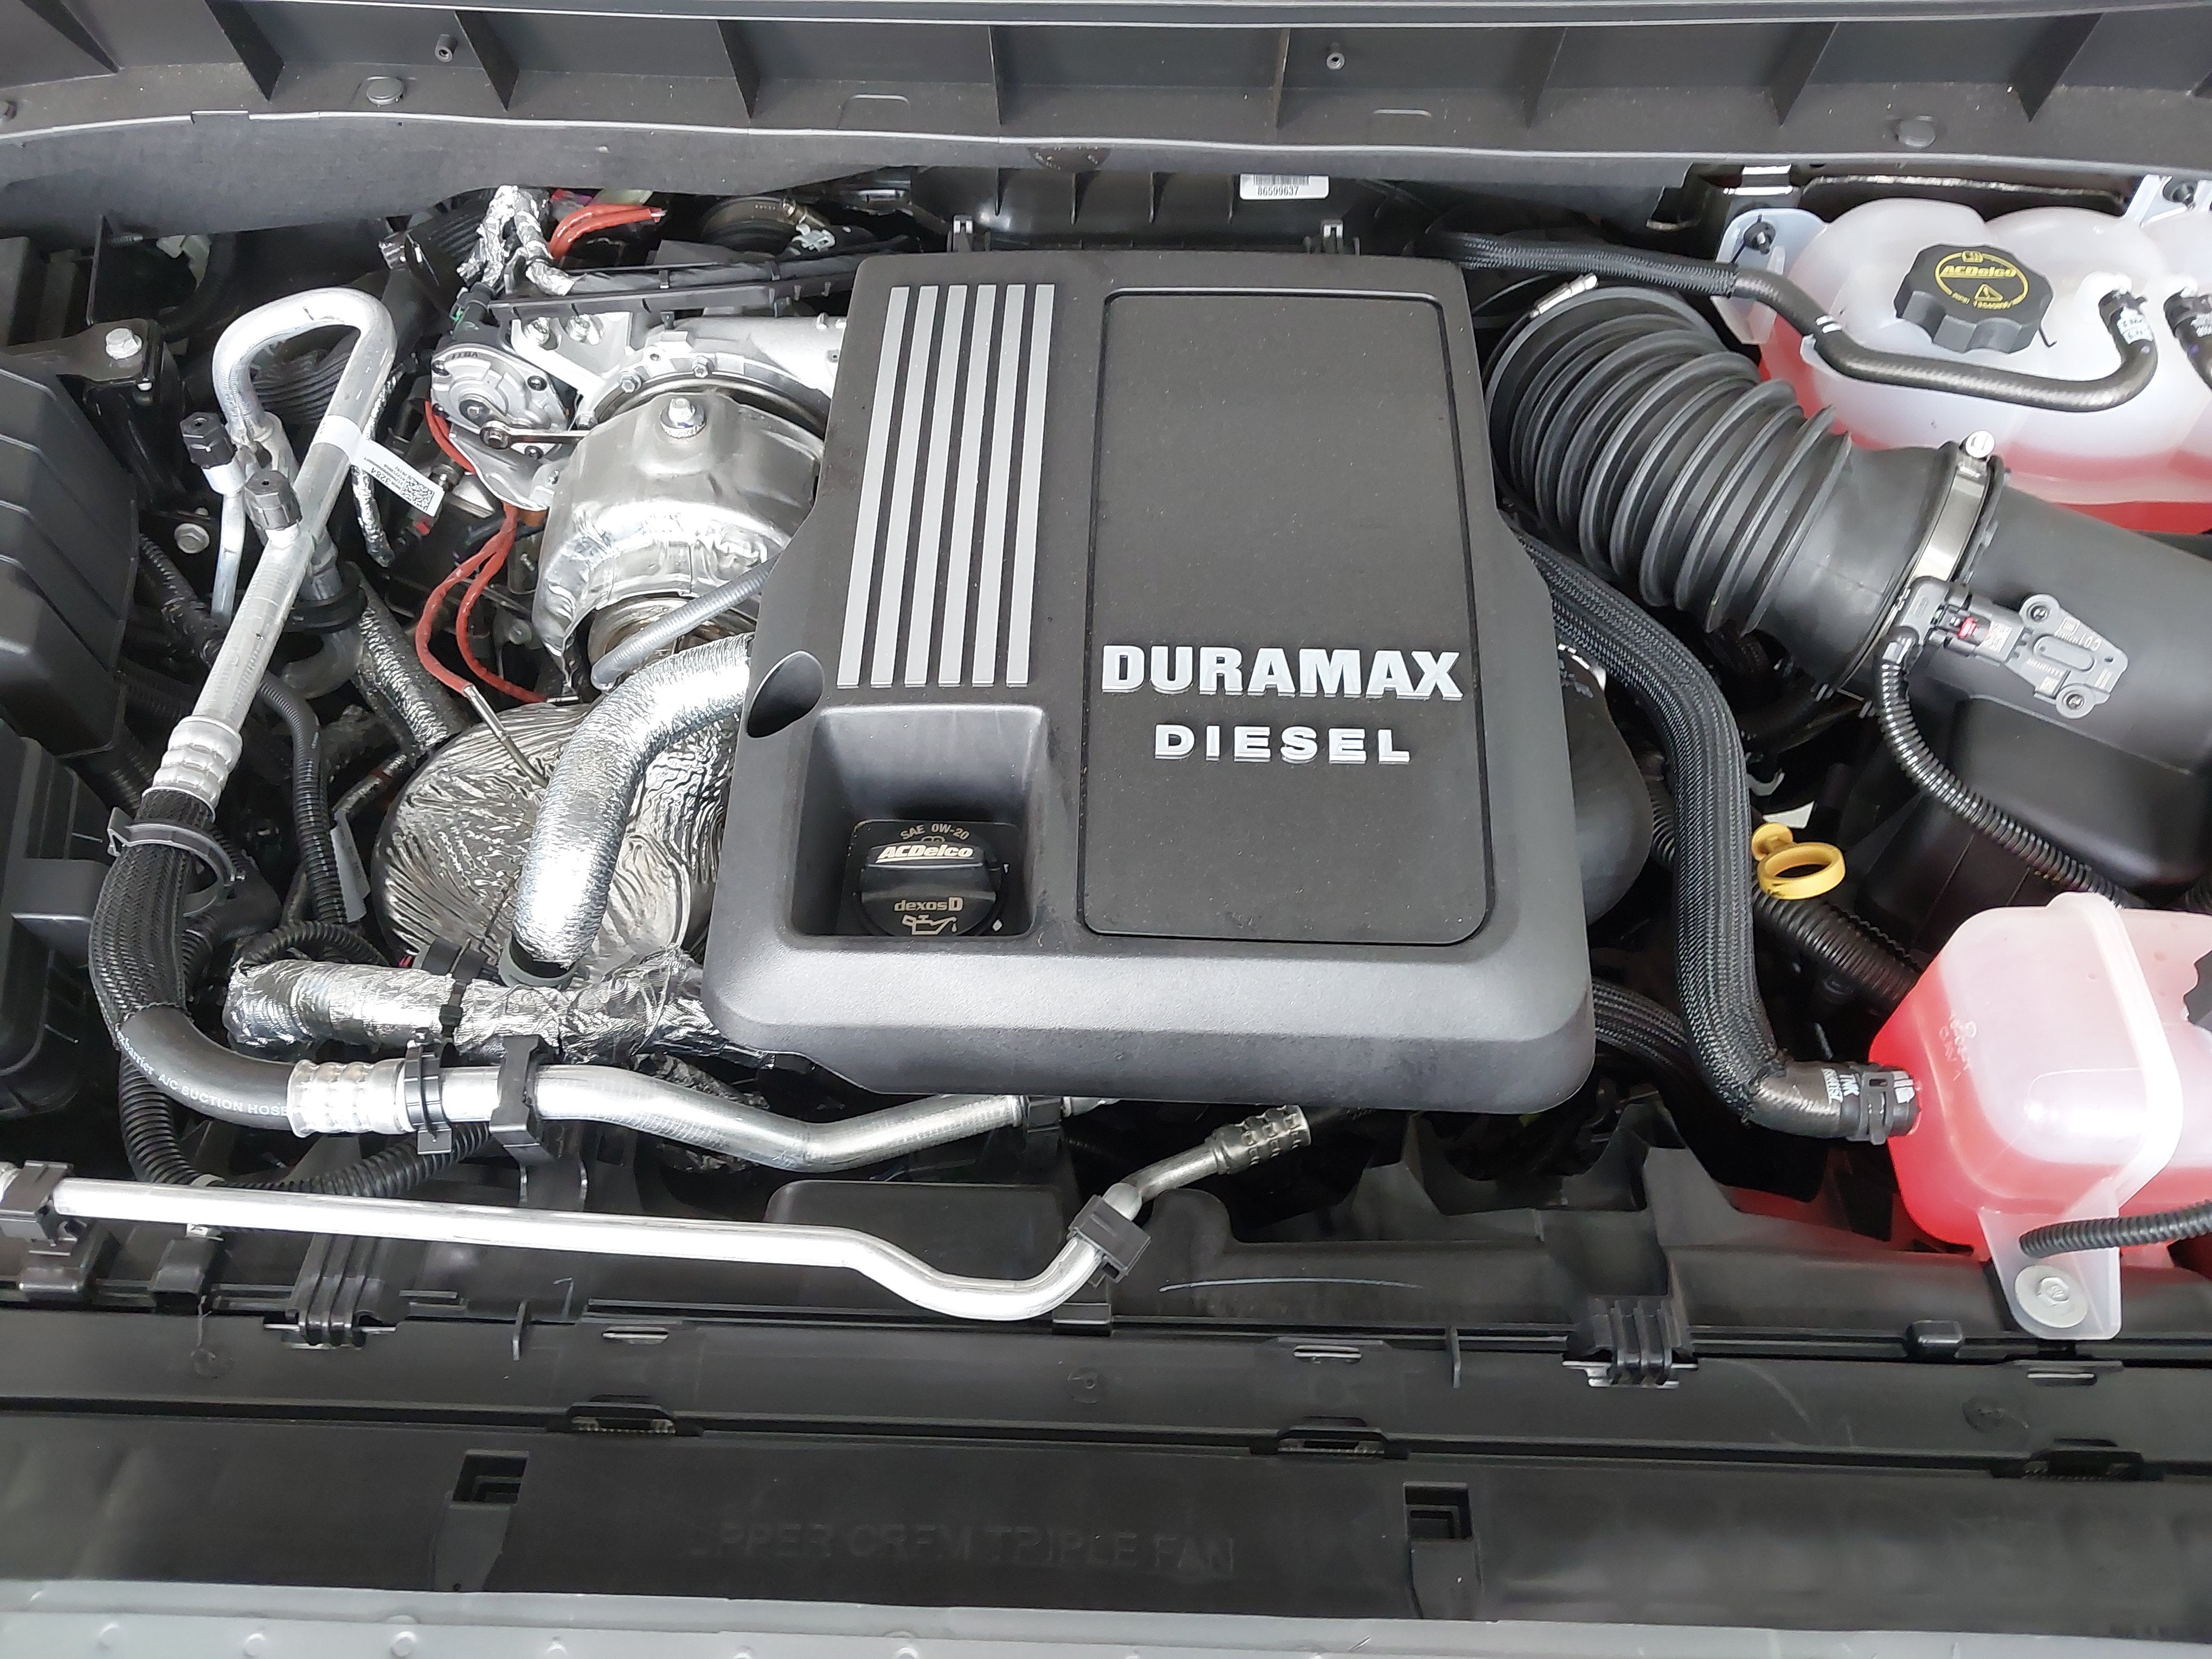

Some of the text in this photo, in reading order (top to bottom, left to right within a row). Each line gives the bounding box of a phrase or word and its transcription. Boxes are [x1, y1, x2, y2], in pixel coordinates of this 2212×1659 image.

[1102, 645, 1463, 700] DURAMAX
[1154, 724, 1411, 764] DIESEL
[877, 844, 974, 859] ACDelco
[900, 824, 925, 840] SAE
[158, 1073, 178, 1090] A/C
[181, 1085, 243, 1112] SUCTION
[248, 1103, 287, 1116] HOSE
[983, 1525, 1138, 1567] TRIPLE
[1153, 1534, 1234, 1572] FAN
